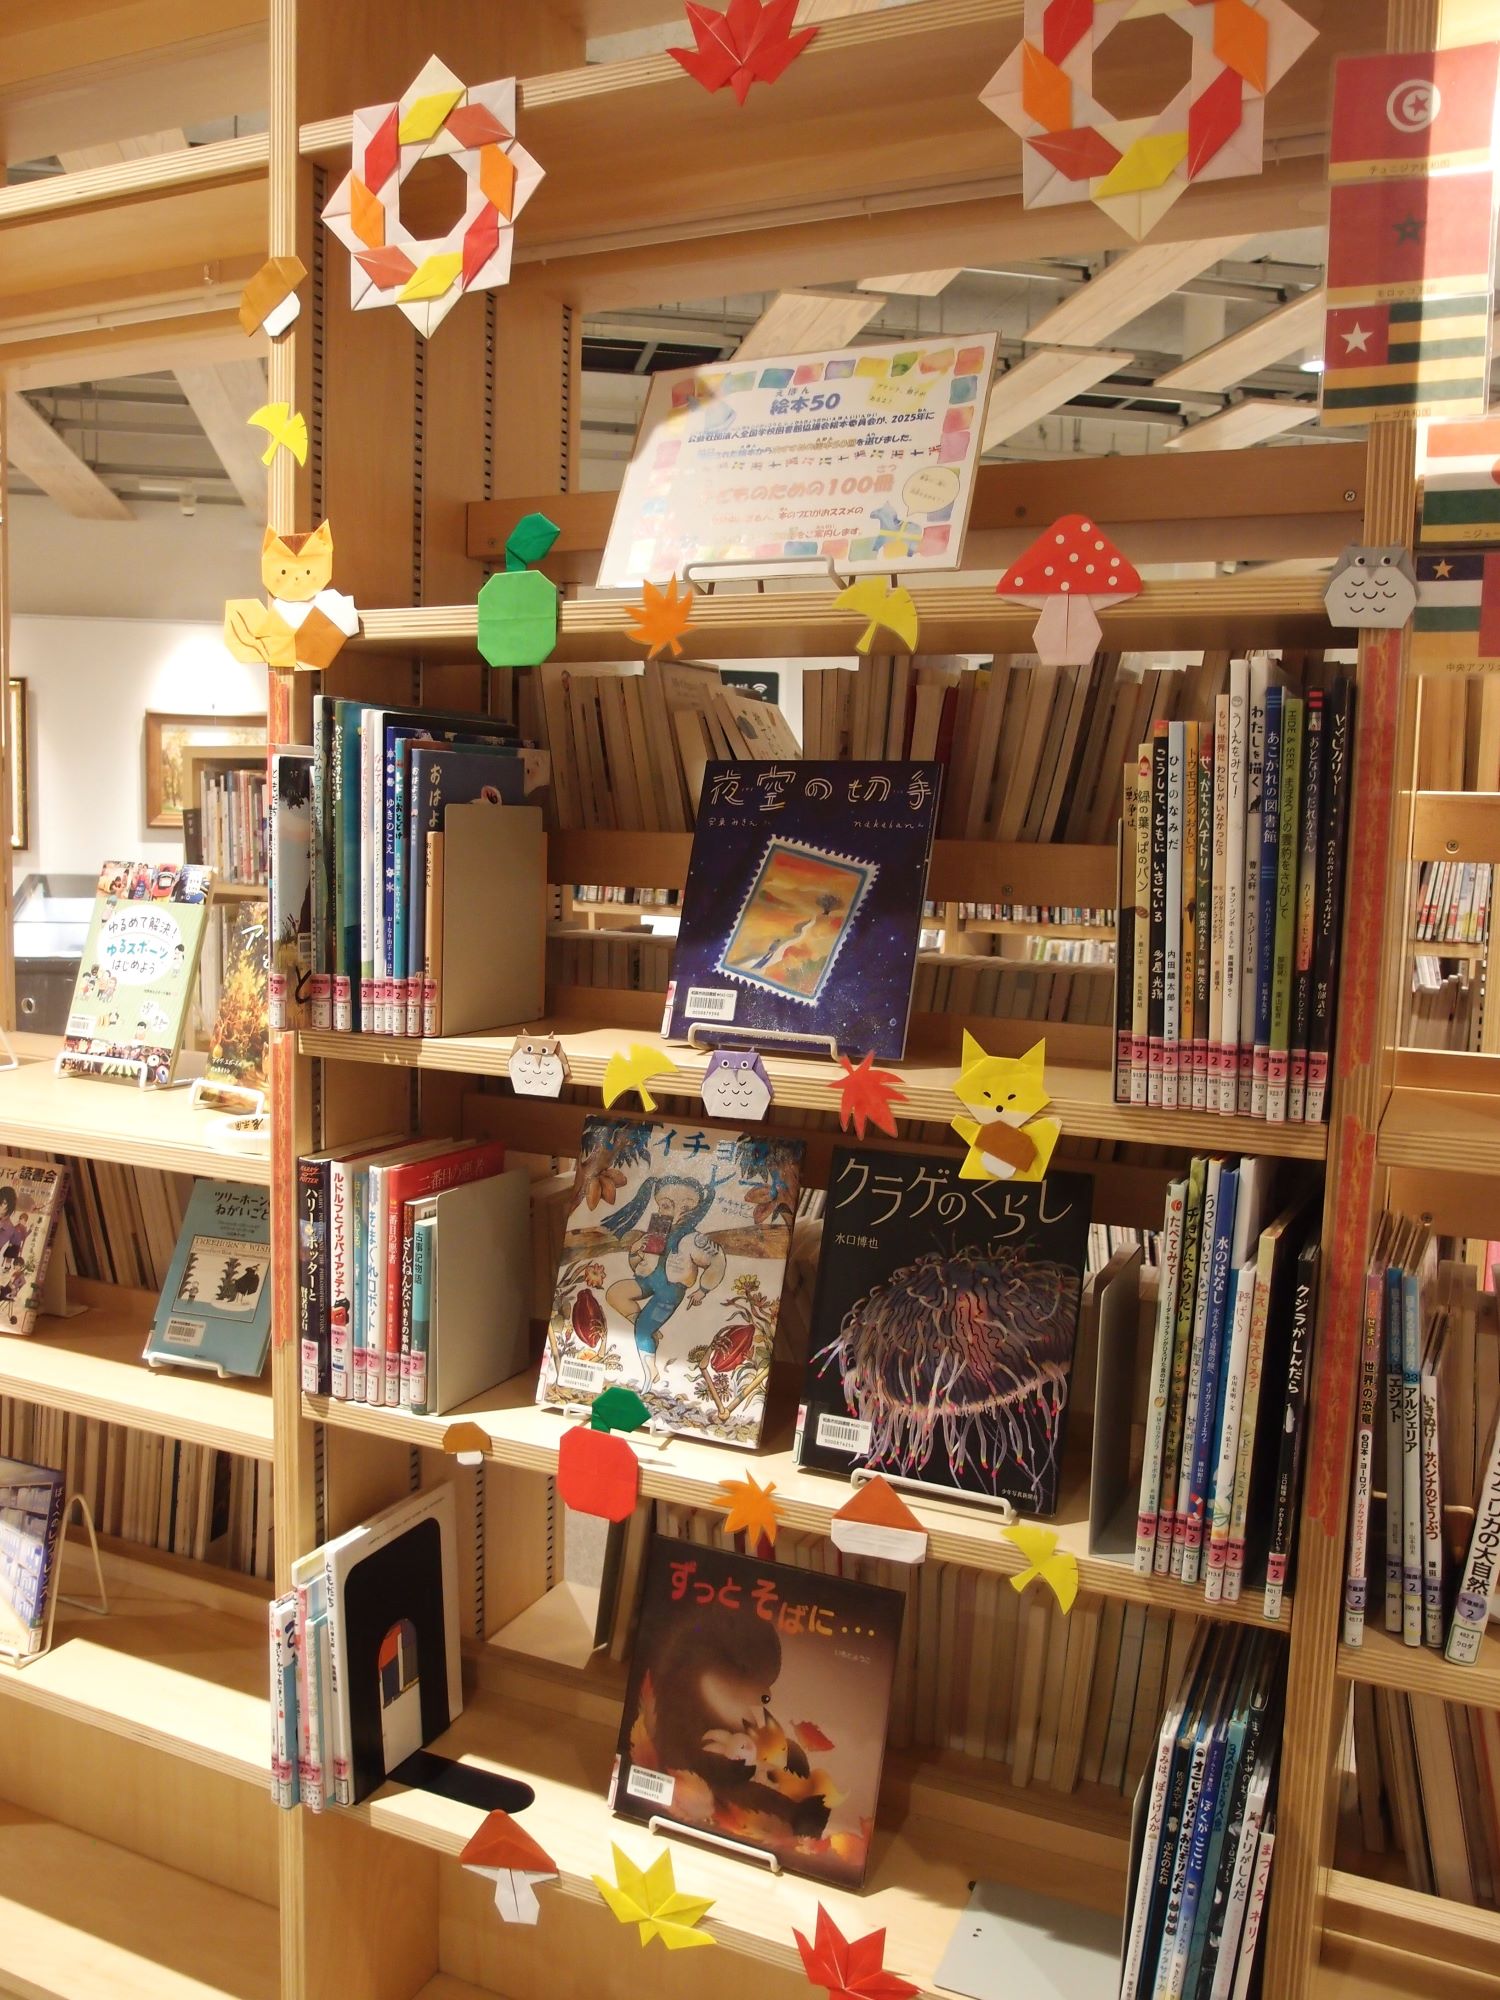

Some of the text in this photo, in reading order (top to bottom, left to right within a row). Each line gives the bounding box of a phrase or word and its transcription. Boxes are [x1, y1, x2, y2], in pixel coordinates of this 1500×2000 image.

[769, 392, 841, 415] 絵本50
[1249, 705, 1263, 788] わたしを描く
[710, 764, 932, 811] 夜空の切手
[1263, 731, 1279, 844] あこがれの図書館
[1167, 755, 1179, 850] ひとのなみだ
[1199, 756, 1212, 872] せっかちなハチドリ
[386, 799, 395, 855] ゆきのこえ
[1137, 789, 1151, 893] 緑の葉っぱのパン
[1152, 861, 1166, 923] いきている
[108, 916, 178, 939] ゆるめて解決!
[106, 939, 168, 959] ゆるスポーツ
[112, 960, 156, 975] はじめよう
[1122, 1046, 1129, 1055] 2
[1136, 1050, 1143, 1059] 2
[1152, 1053, 1160, 1062] 2
[1166, 1056, 1173, 1065] 2
[1184, 1055, 1191, 1064] 2
[1196, 1055, 1203, 1064] 2
[1211, 1057, 1218, 1066] 2
[1224, 1059, 1231, 1068] 2
[1243, 1058, 1250, 1067] 2
[1273, 1067, 1281, 1077] 2
[1295, 1066, 1302, 1075] 2
[1312, 1068, 1319, 1078] 2
[19, 1165, 57, 1184] 読書会
[835, 1157, 1073, 1239] クラゲのくらし
[333, 1172, 345, 1298] ルドルフとイッパイアッテナ
[834, 1231, 880, 1249] 水口博也
[1178, 1207, 1199, 1323] チョウになりたい
[1212, 1236, 1229, 1305] 水のはなし
[401, 1236, 414, 1353] ざんねんないきもの事典
[1287, 1285, 1310, 1395] クジラがしんだら
[1362, 1361, 1375, 1425] 世界の恐竜
[1389, 1378, 1402, 1423] エジプト
[1404, 1387, 1418, 1453] アルジェリア
[1424, 1451, 1439, 1540] サバンナのどうぶつ
[1143, 1527, 1150, 1536] 2
[1163, 1526, 1170, 1534] 2
[1175, 1527, 1181, 1535] 2
[1189, 1534, 1196, 1543] 2
[1214, 1553, 1220, 1562] 2
[1231, 1552, 1238, 1561] 2
[1272, 1570, 1280, 1579] 2
[1390, 1570, 1397, 1579] 2
[669, 1560, 743, 1610] ずっと
[1409, 1583, 1416, 1592] 2
[1354, 1595, 1362, 1604] 2
[1429, 1594, 1436, 1603] 2
[1466, 1609, 1474, 1619] 2
[1197, 1798, 1214, 1833] ぼくが
